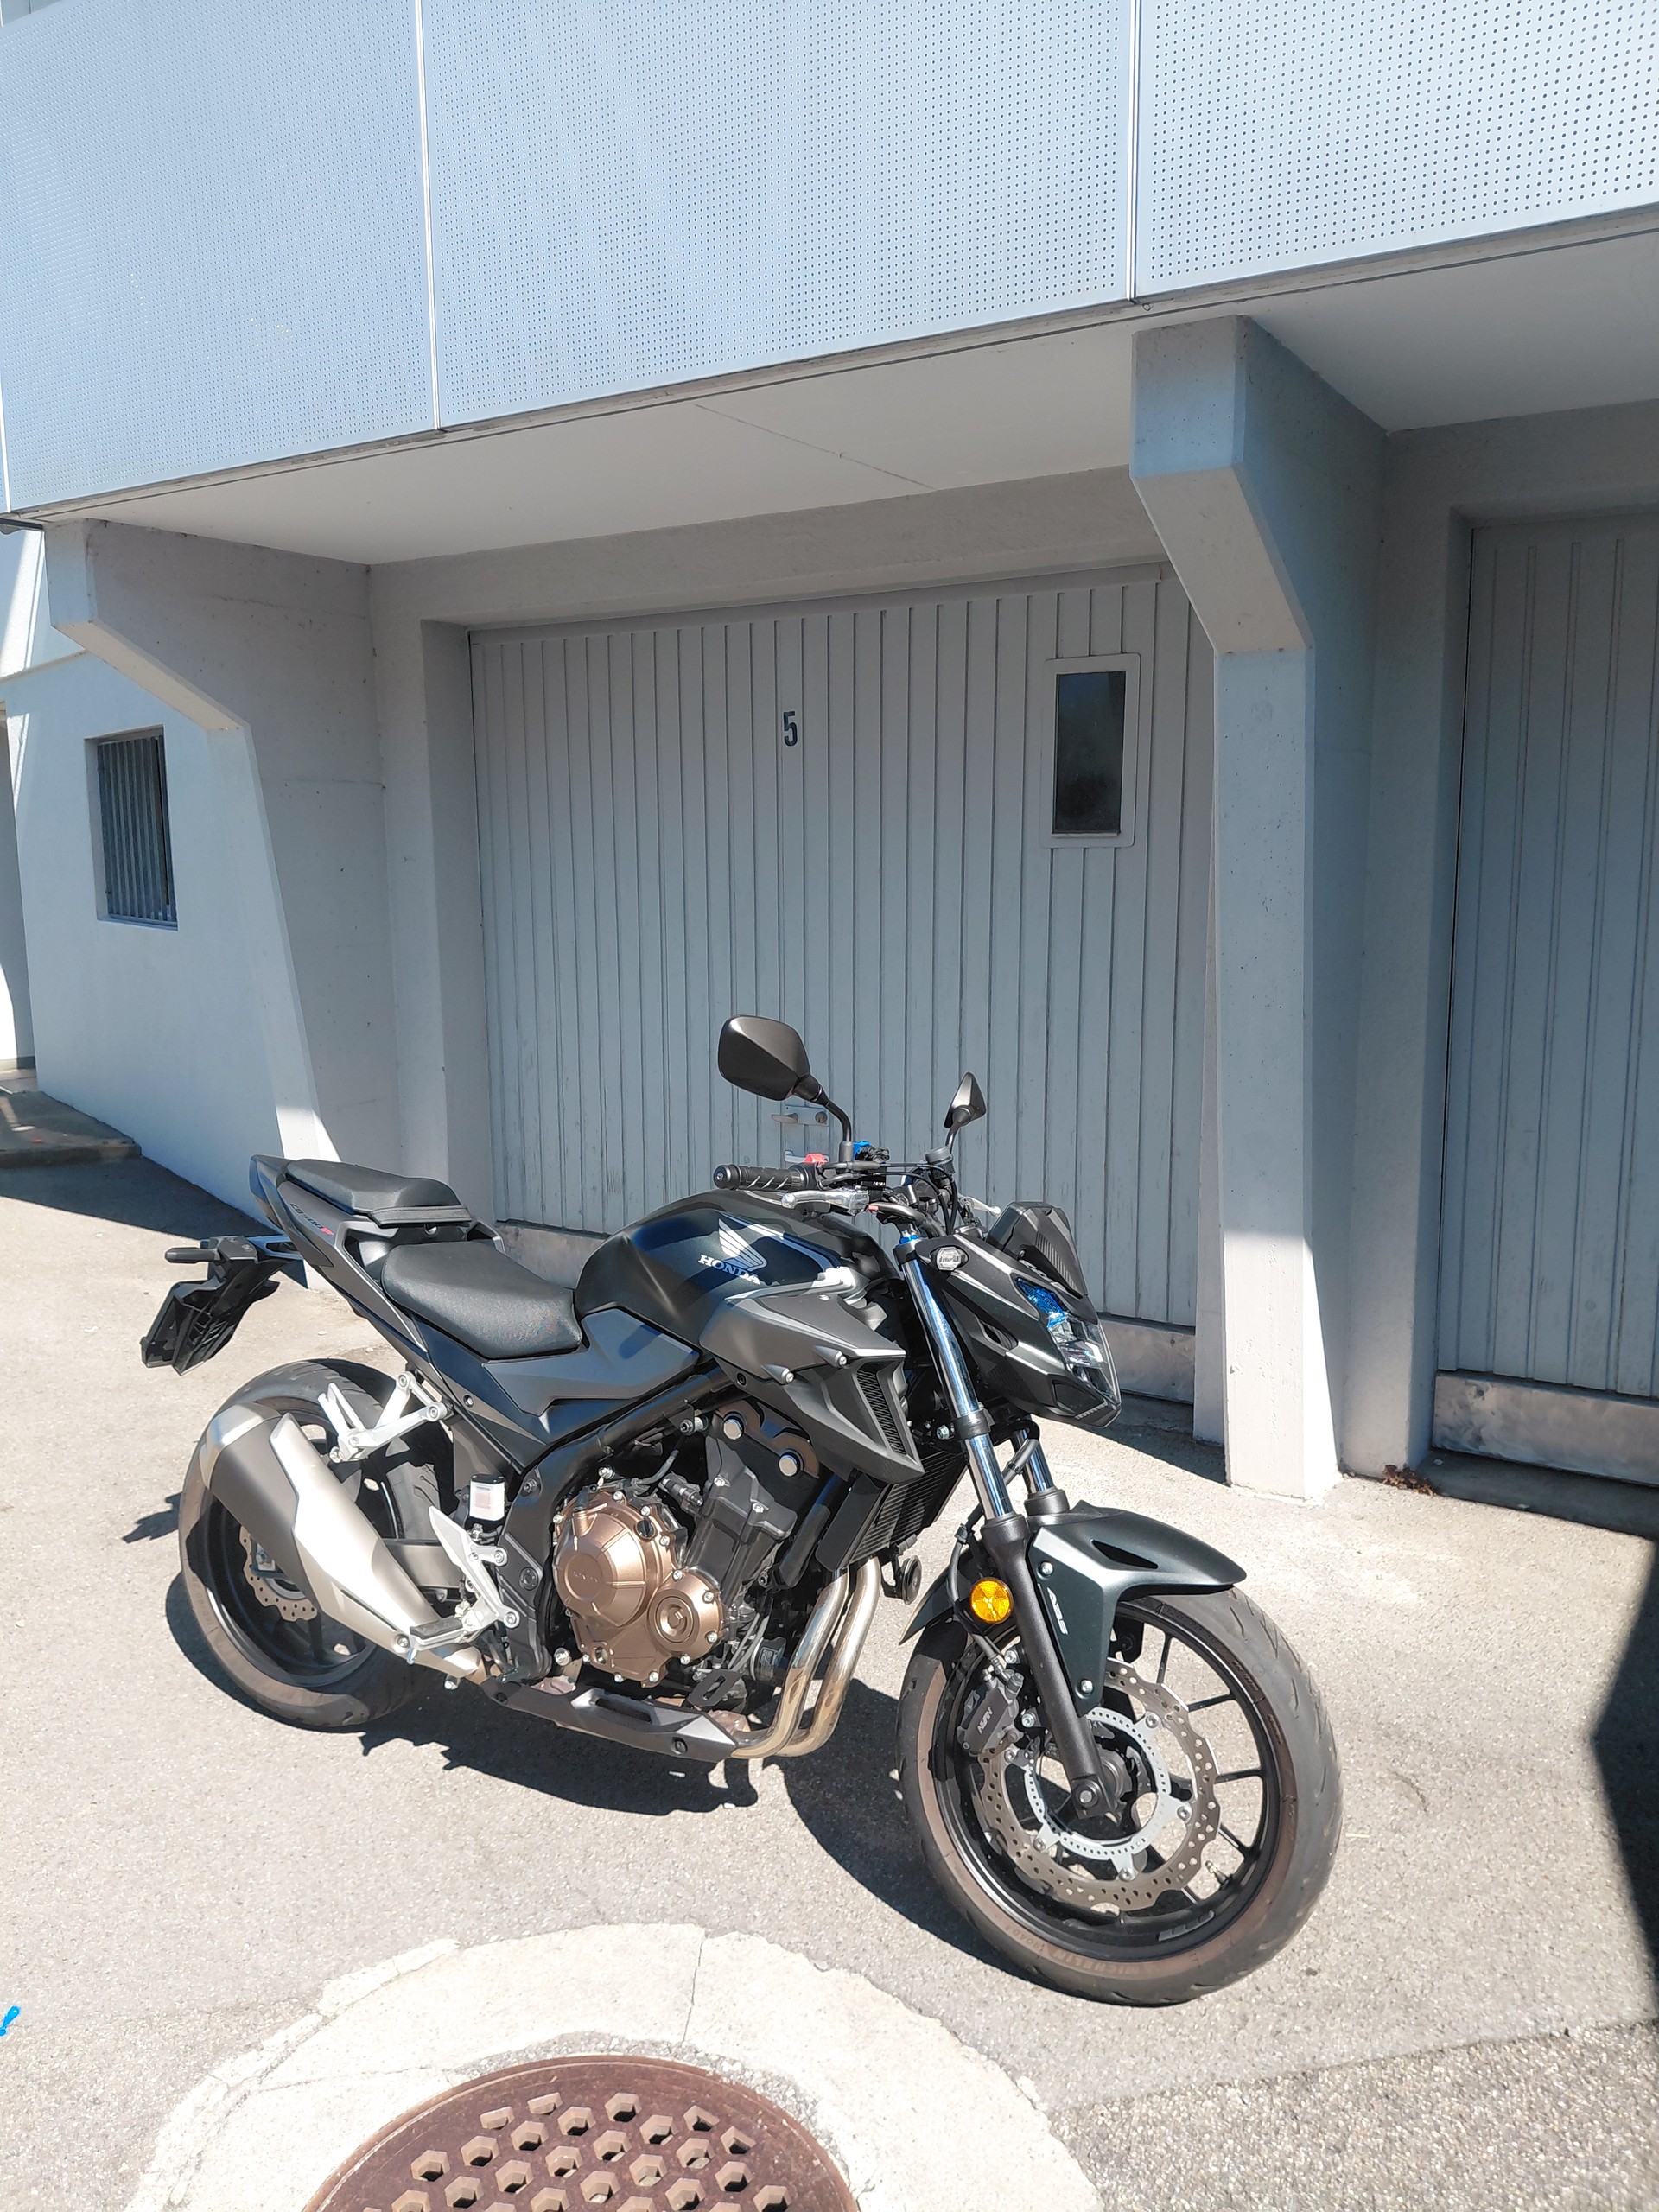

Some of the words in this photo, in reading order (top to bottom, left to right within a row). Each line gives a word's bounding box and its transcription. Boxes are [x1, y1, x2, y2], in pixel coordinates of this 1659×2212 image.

[783, 710, 798, 747] 5
[697, 1254, 761, 1286] HONDA
[1046, 1586, 1069, 1636] ABS
